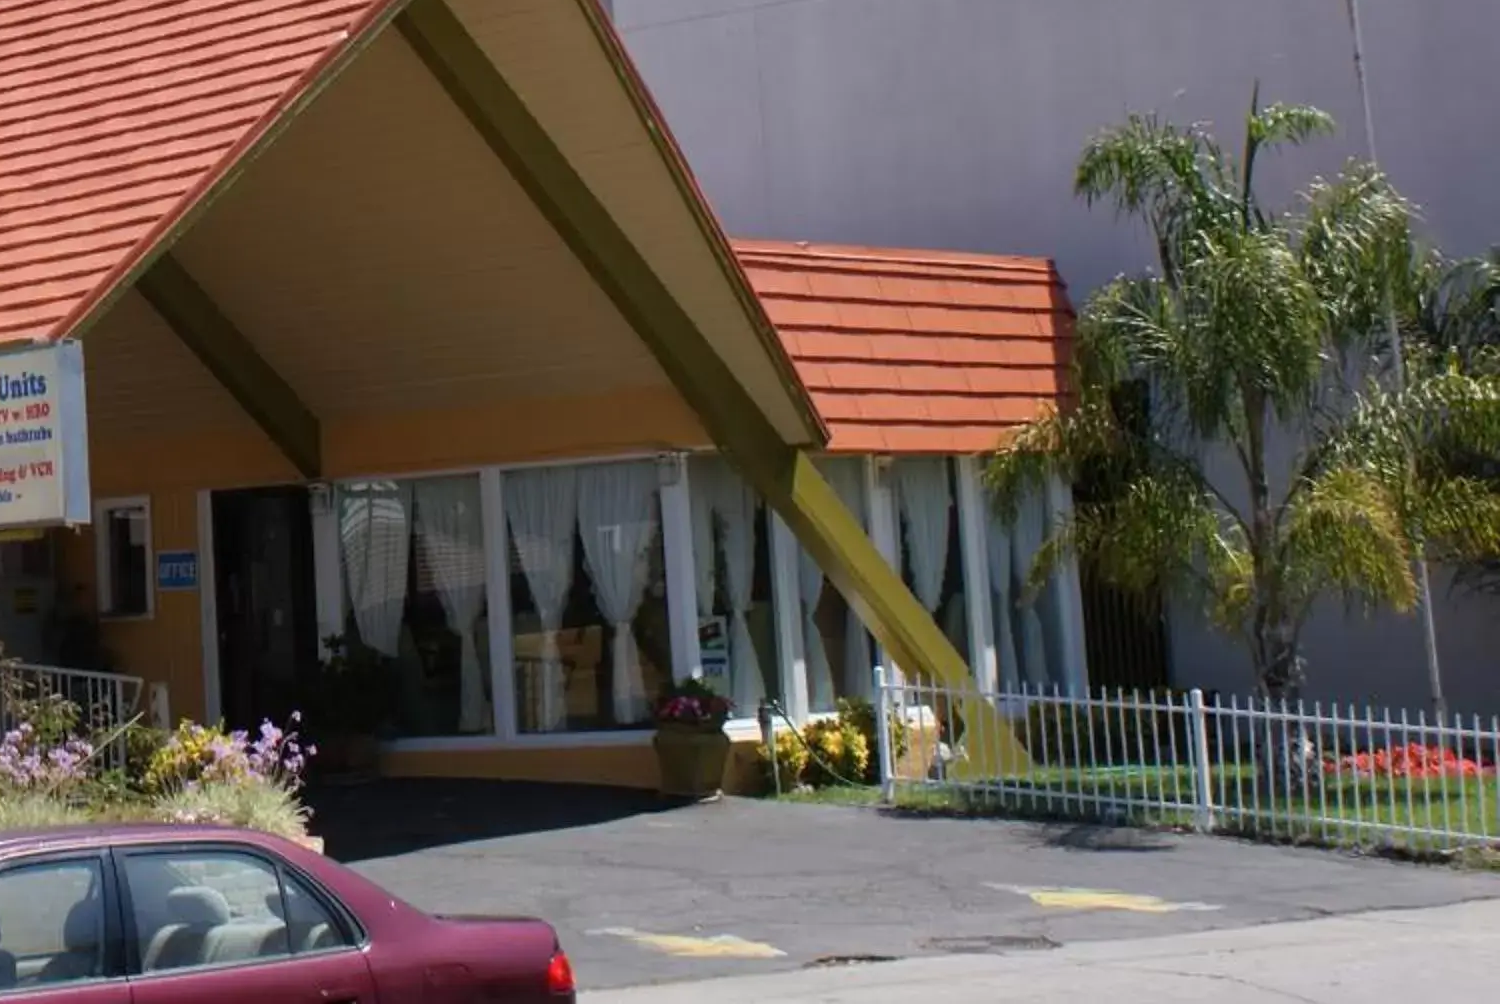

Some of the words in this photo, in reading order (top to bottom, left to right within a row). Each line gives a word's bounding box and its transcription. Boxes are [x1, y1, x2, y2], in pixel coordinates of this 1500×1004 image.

[26, 403, 50, 420] HBO
[5, 426, 52, 444] bathtubs
[30, 461, 53, 476] VCR
